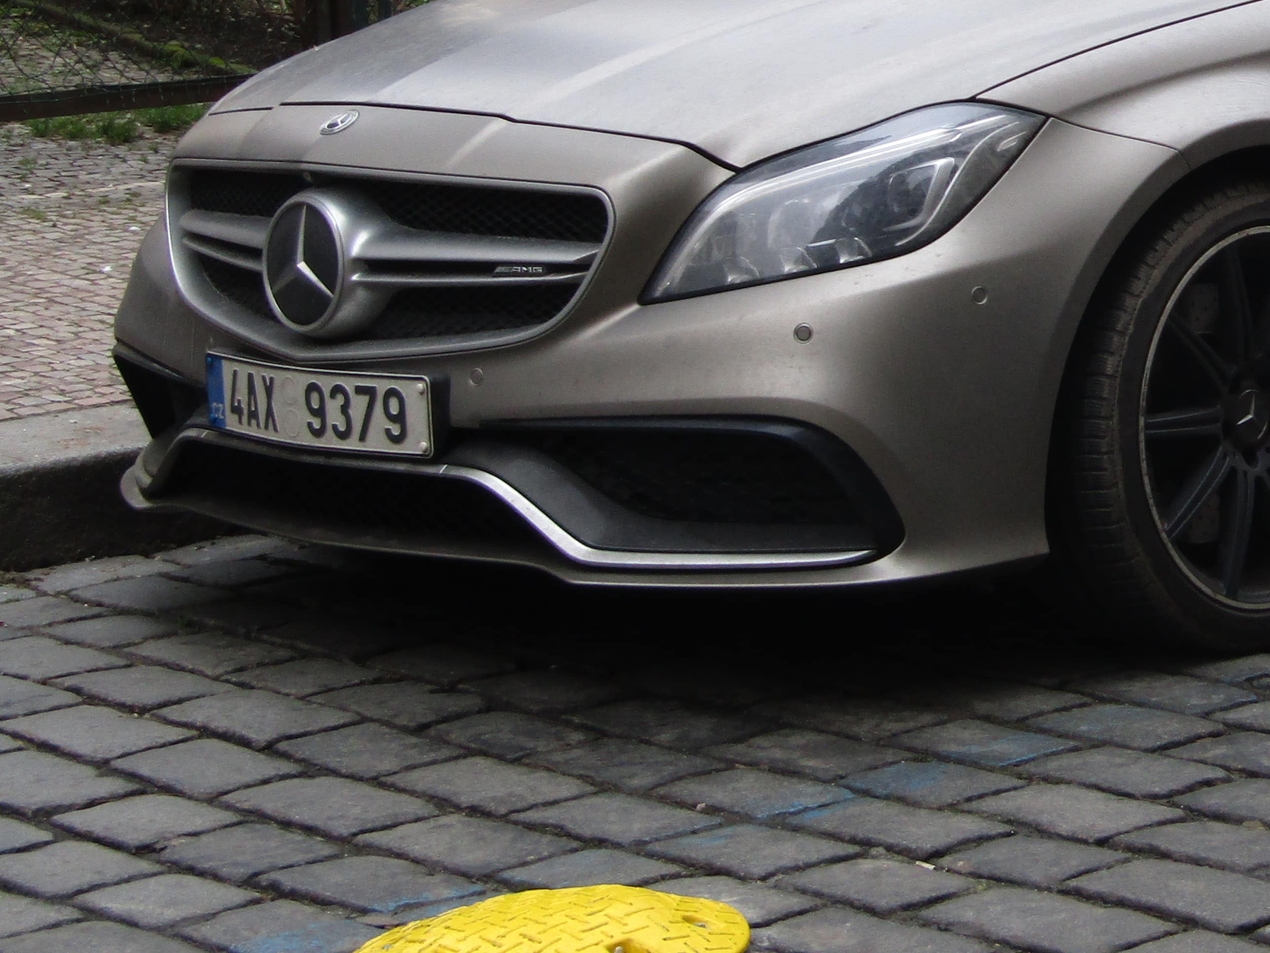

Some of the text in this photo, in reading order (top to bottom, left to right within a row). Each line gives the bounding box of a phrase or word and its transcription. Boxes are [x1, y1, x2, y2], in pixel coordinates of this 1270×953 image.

[512, 266, 543, 274] AMG
[211, 402, 225, 419] CZ
[230, 367, 408, 445] 4AX 9379
